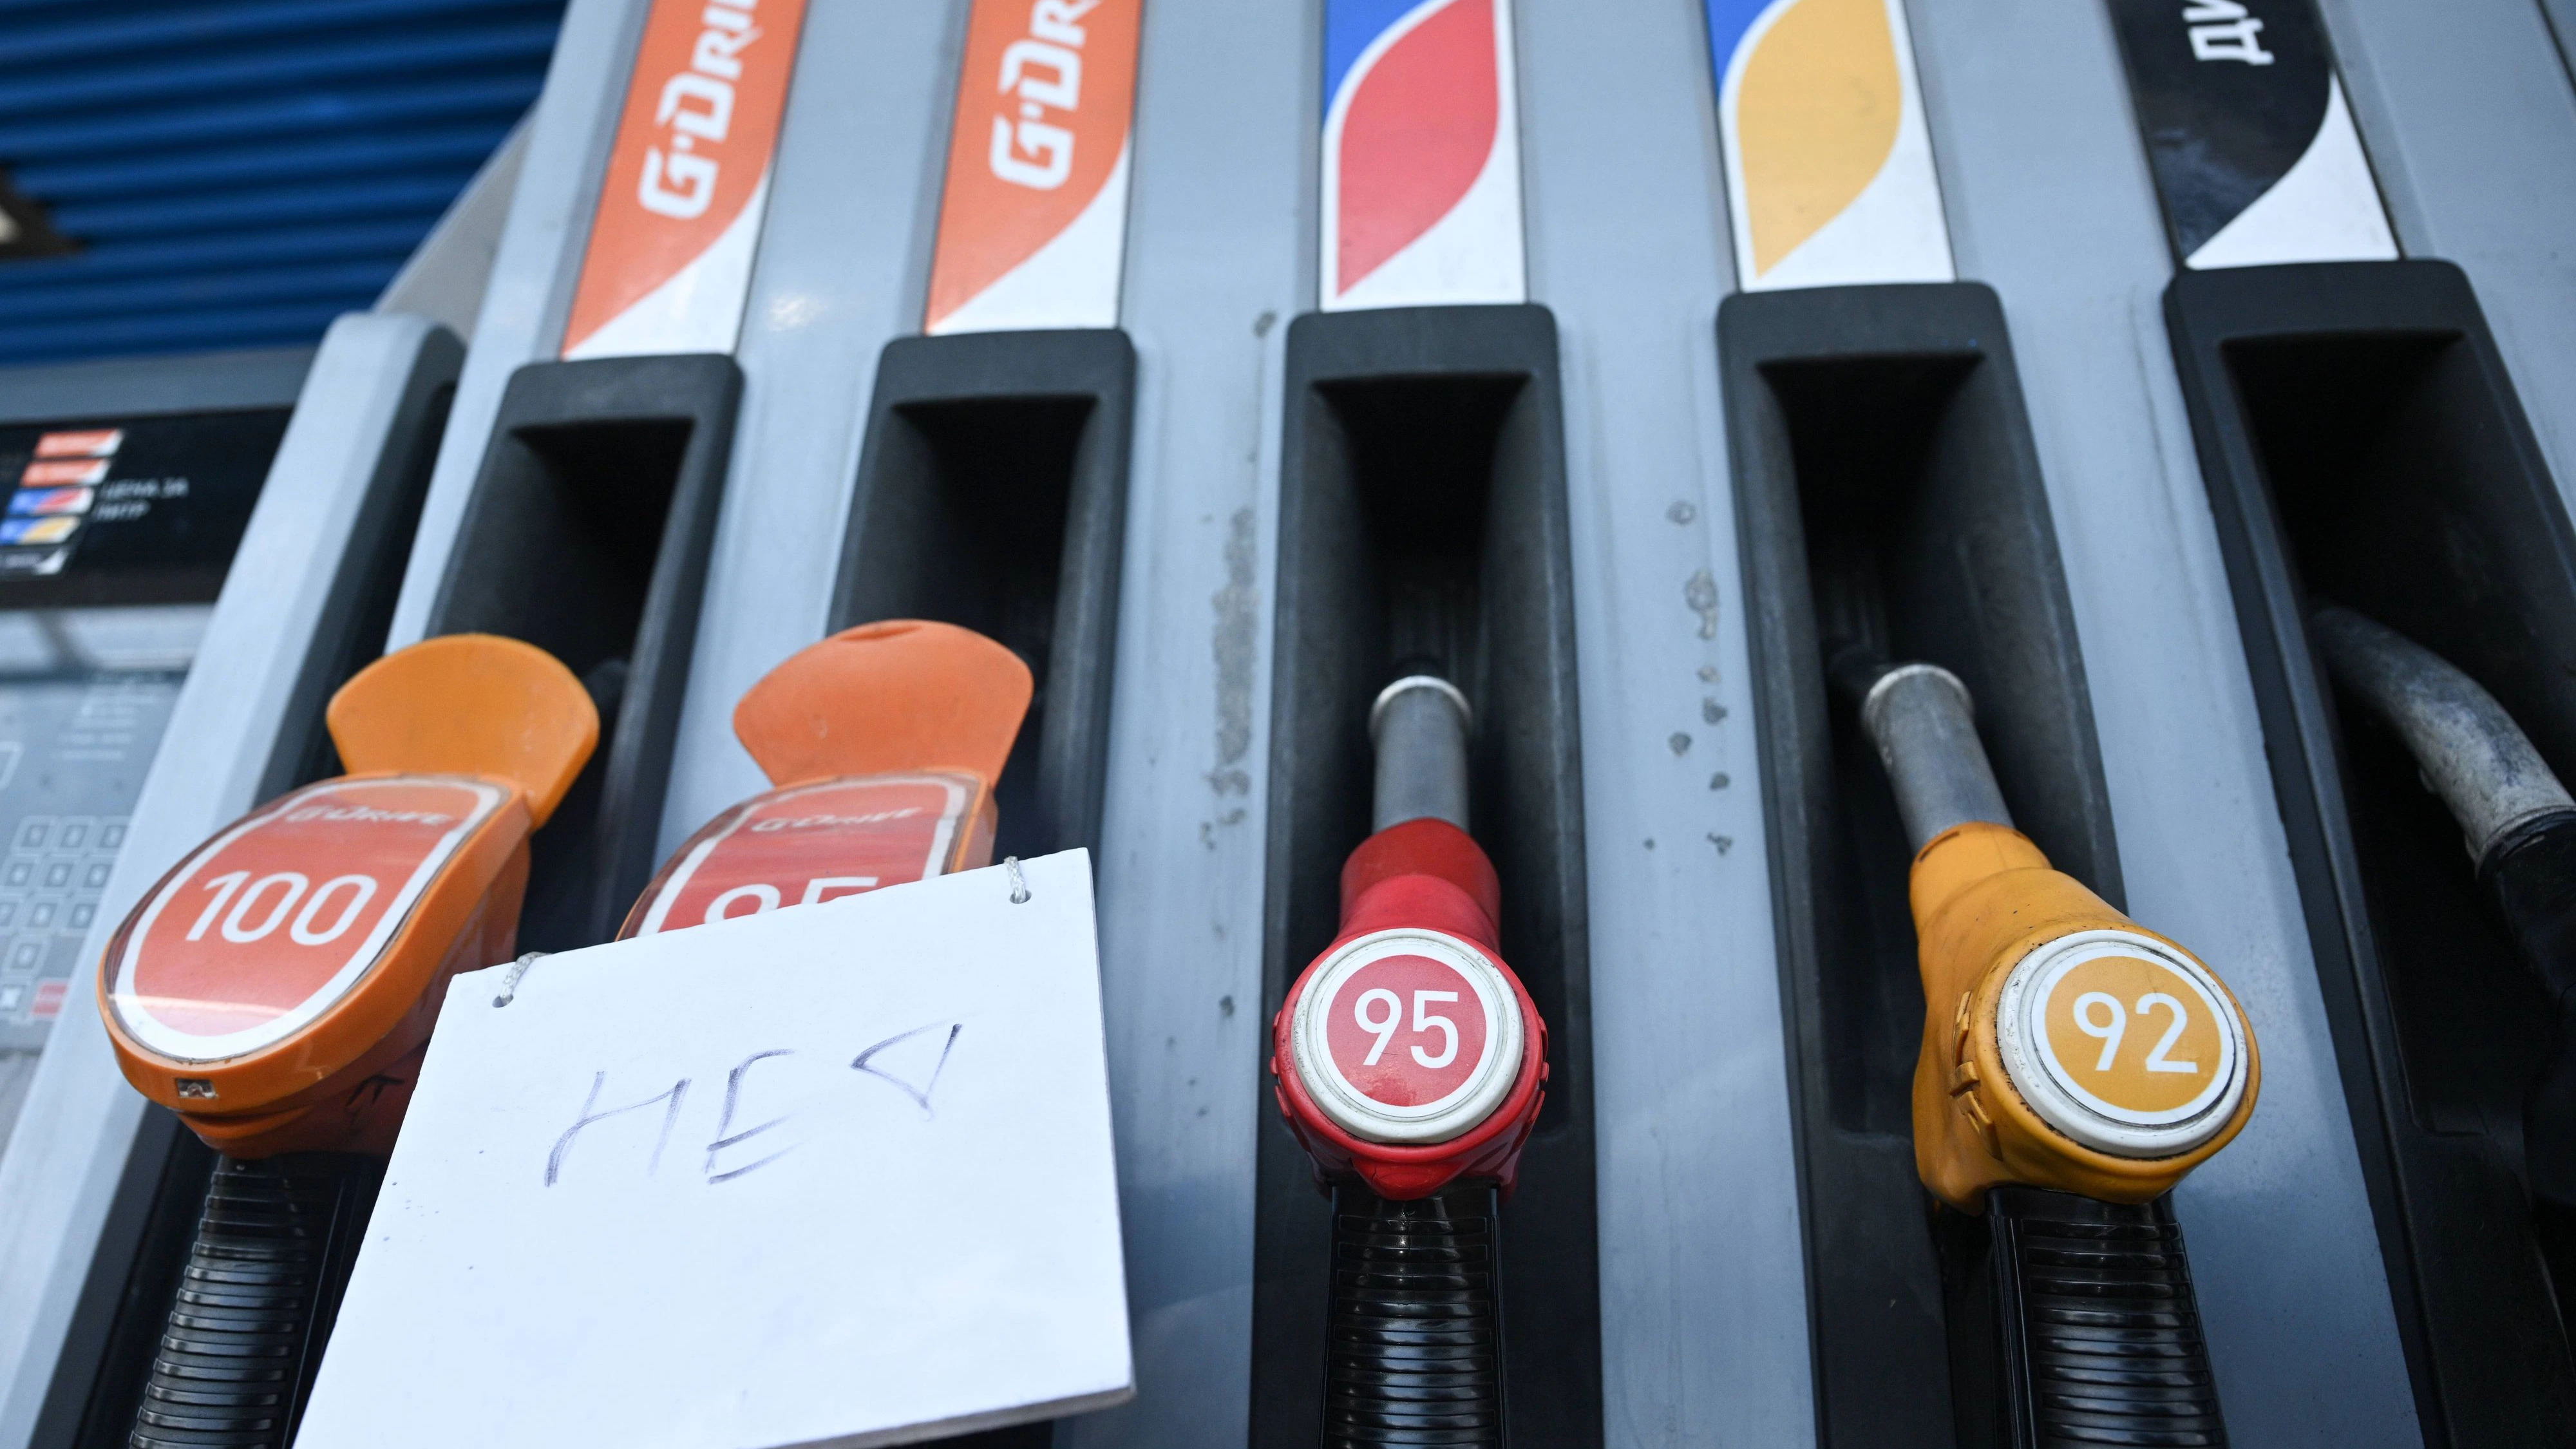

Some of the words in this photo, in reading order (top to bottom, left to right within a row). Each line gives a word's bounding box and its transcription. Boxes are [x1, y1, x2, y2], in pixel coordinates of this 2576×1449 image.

[185, 871, 377, 945] 100
[1354, 988, 1459, 1069] 95
[2072, 991, 2198, 1074] 92
